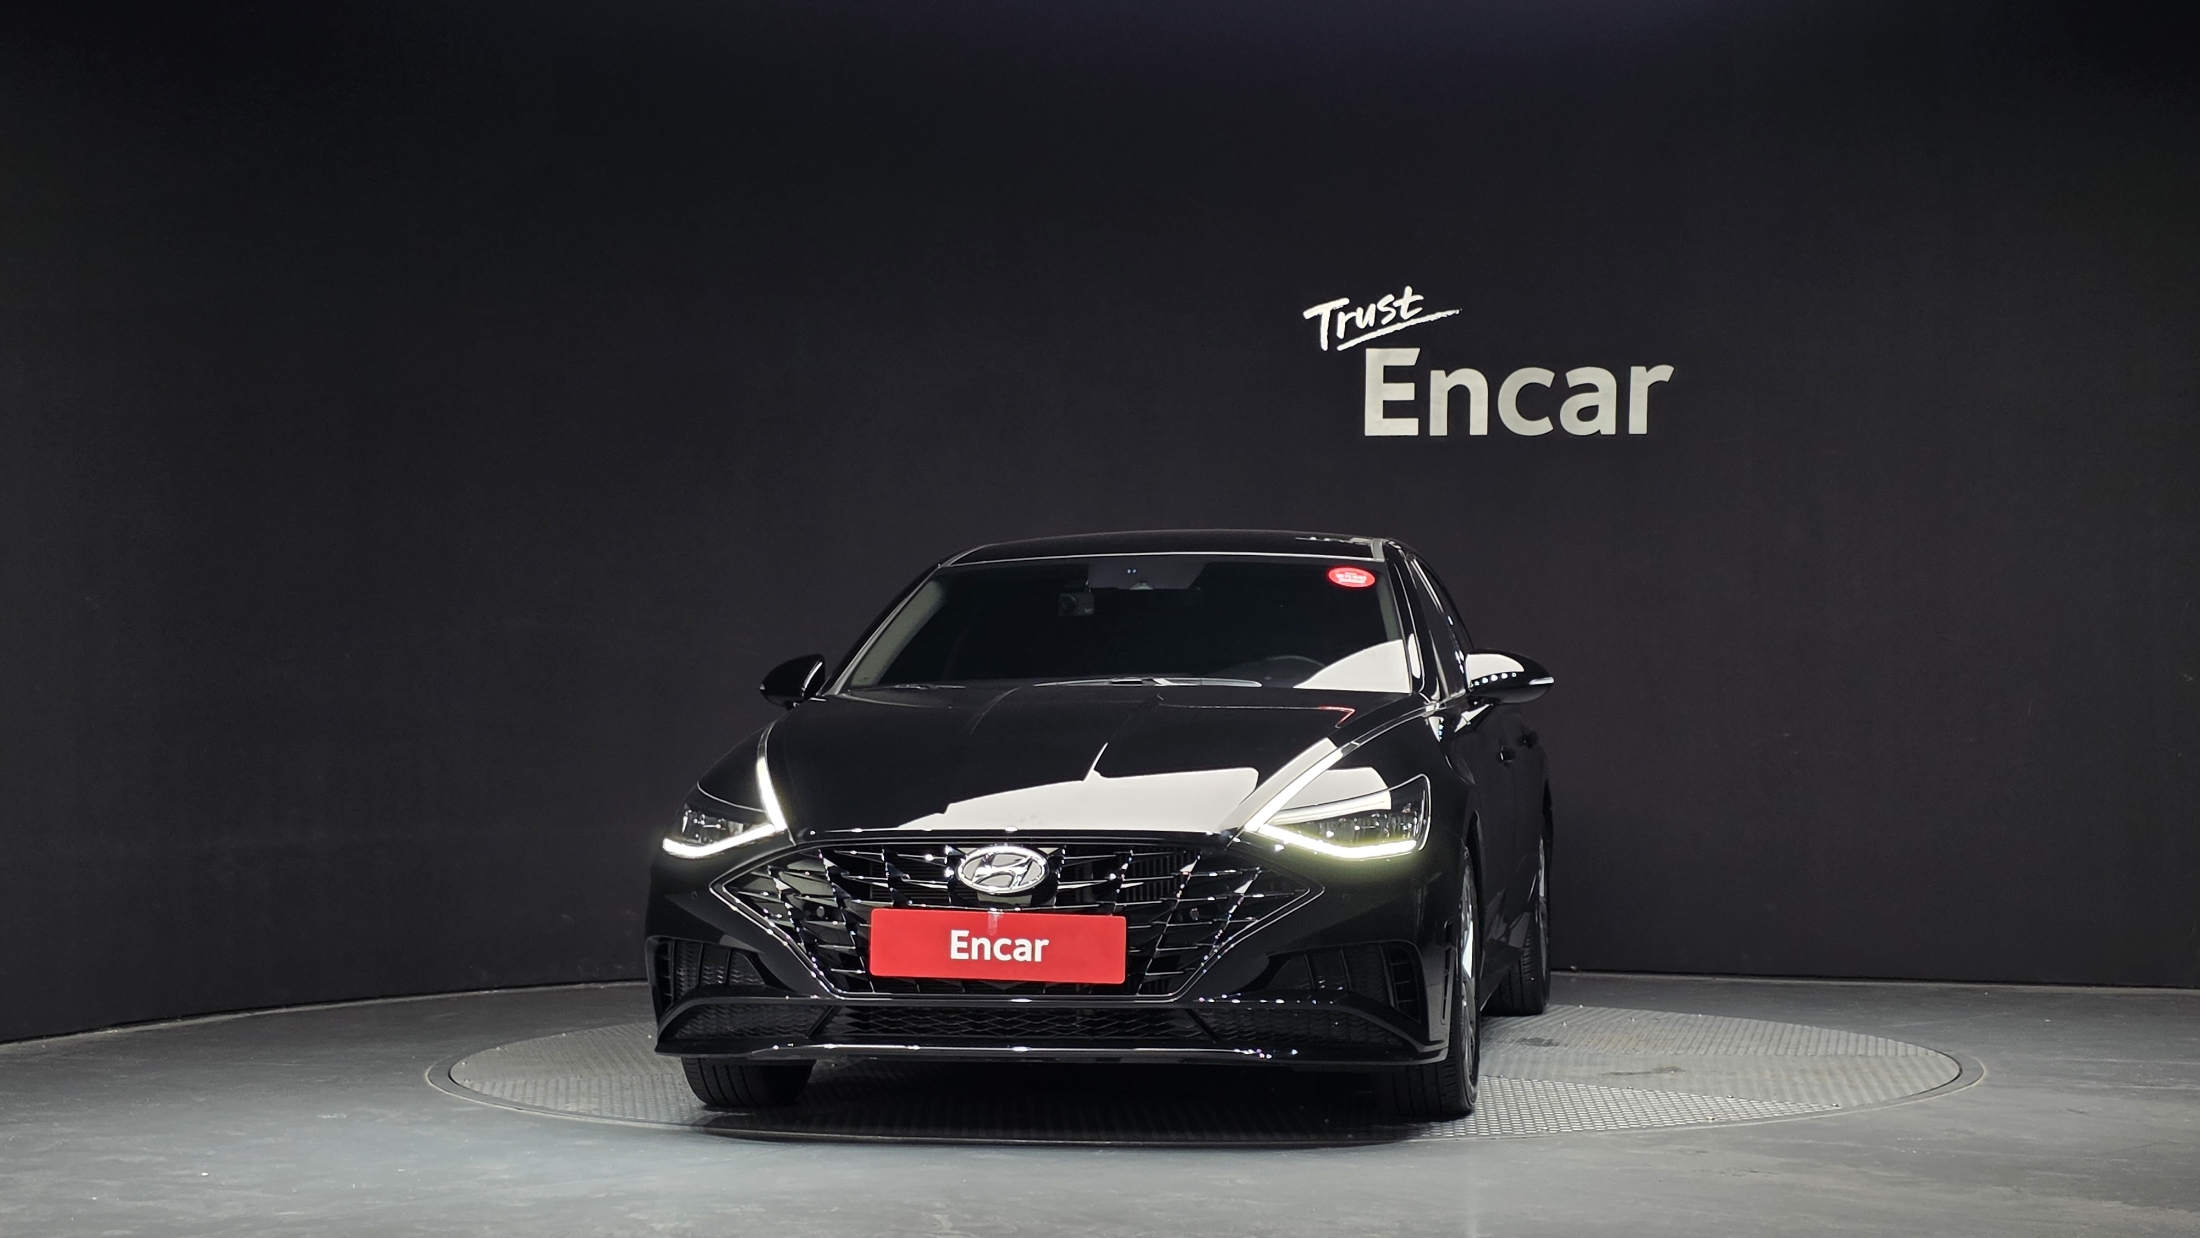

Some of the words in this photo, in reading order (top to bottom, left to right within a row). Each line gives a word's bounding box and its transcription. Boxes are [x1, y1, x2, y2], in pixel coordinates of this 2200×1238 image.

[1303, 286, 1425, 350] Trust
[1364, 348, 1674, 436] Encar
[950, 929, 1049, 962] Encar
